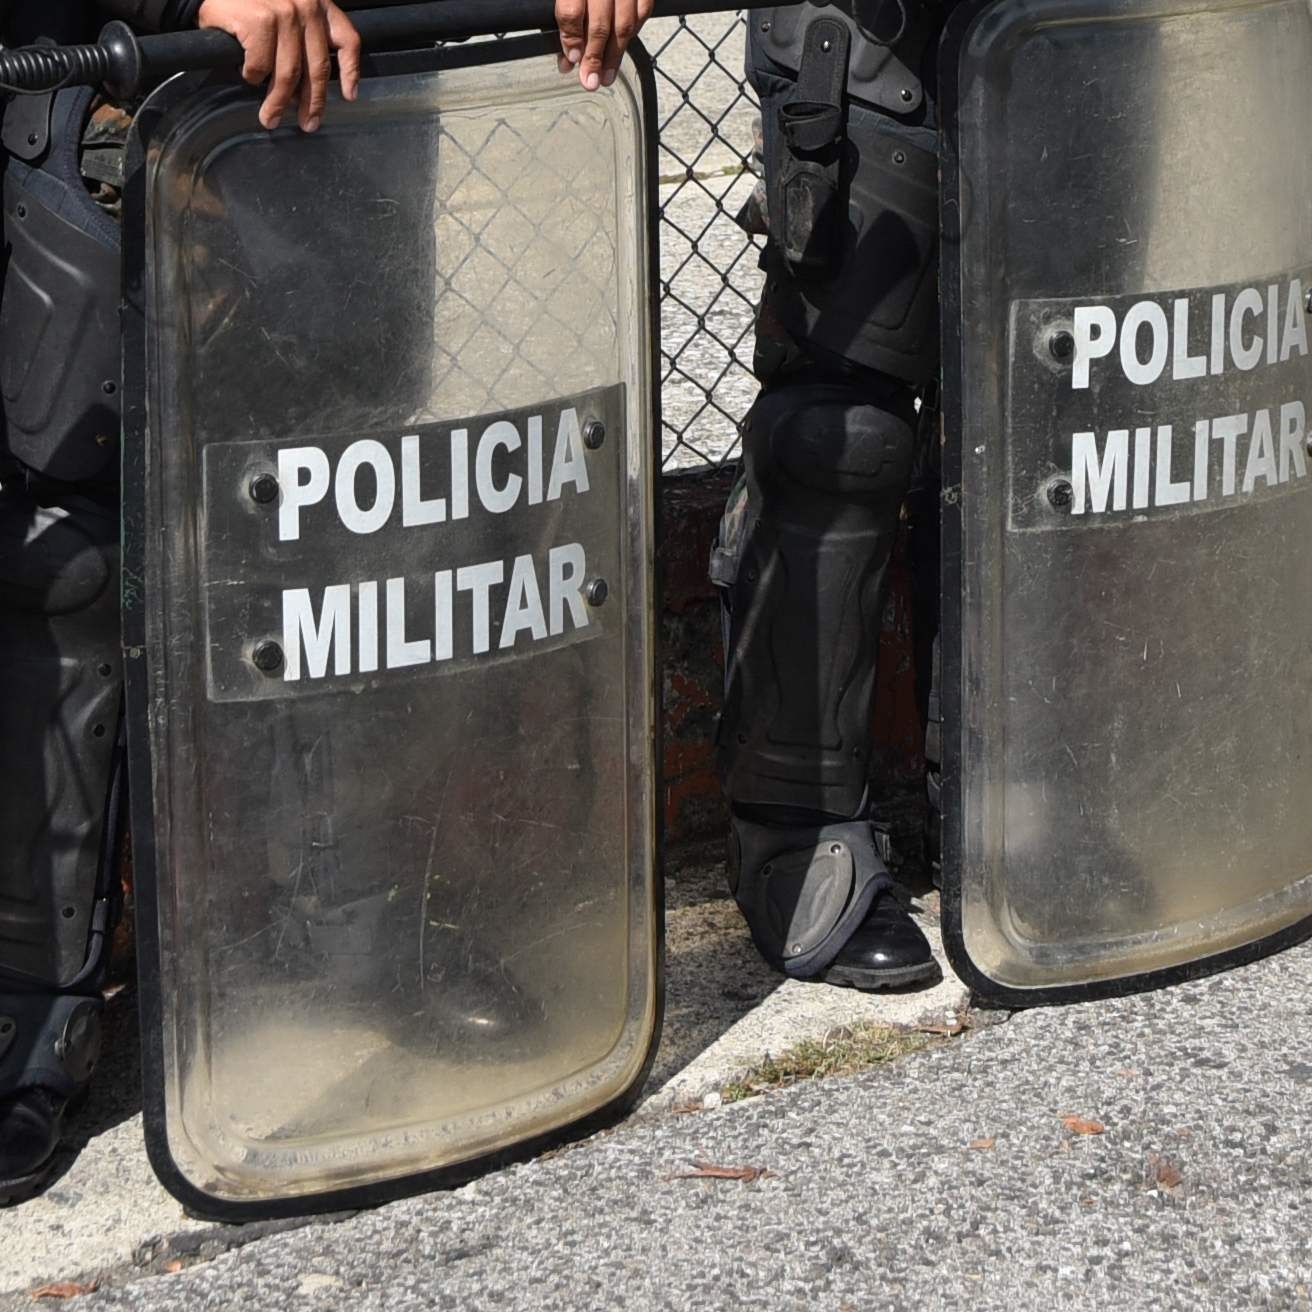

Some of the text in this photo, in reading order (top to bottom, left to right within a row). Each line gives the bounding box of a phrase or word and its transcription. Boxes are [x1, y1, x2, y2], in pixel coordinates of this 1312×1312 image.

[1072, 278, 1308, 389] POLICIA
[277, 407, 590, 541] POLICIA
[1071, 400, 1308, 515] MILITAR
[282, 542, 589, 682] MILITAR
